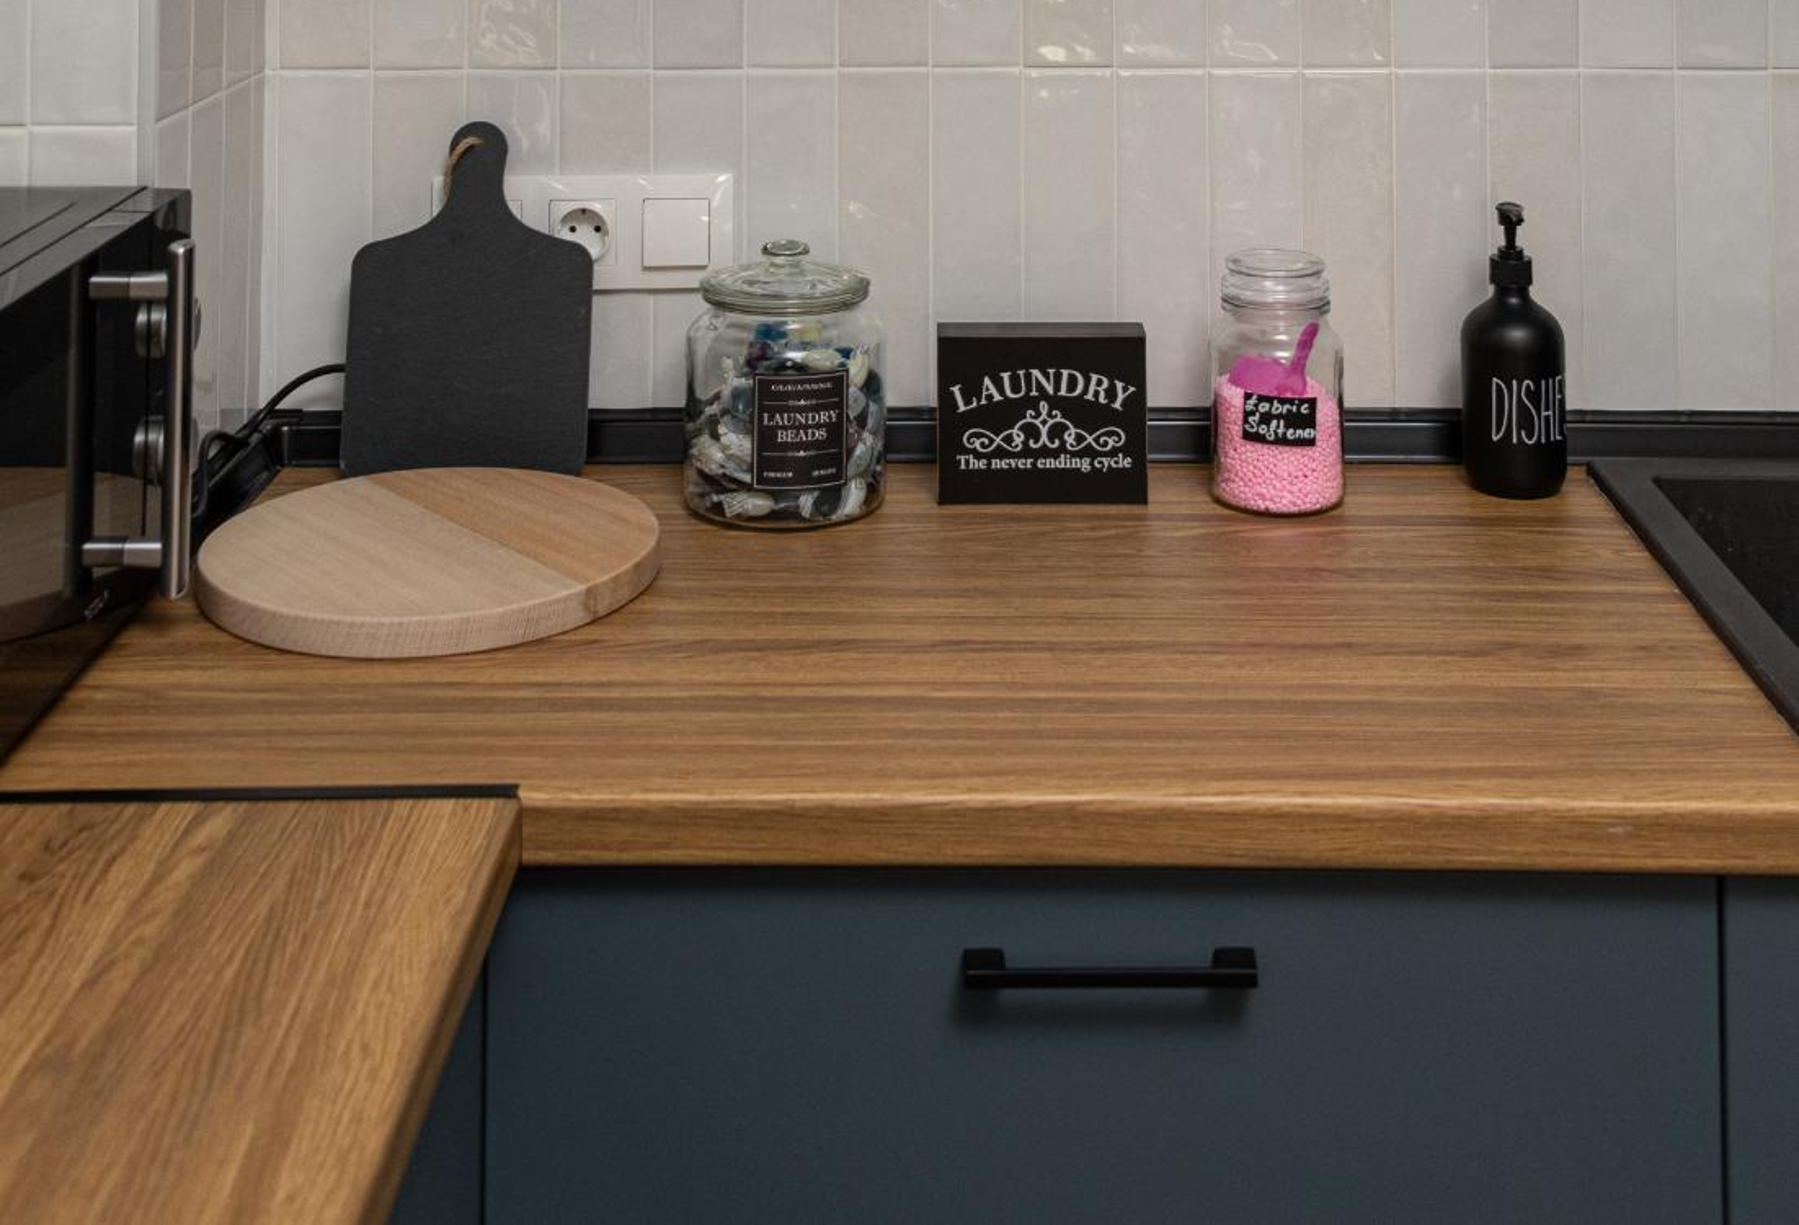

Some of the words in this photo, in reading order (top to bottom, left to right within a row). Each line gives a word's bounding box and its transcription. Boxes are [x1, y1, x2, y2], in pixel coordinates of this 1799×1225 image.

[949, 368, 1136, 413] LAUNDRY
[762, 409, 838, 426] LAUNDRY
[776, 427, 827, 443] BEADS
[956, 454, 987, 470] The
[991, 456, 1033, 469] never
[1036, 454, 1091, 472] ending
[1093, 453, 1133, 472] cycle
